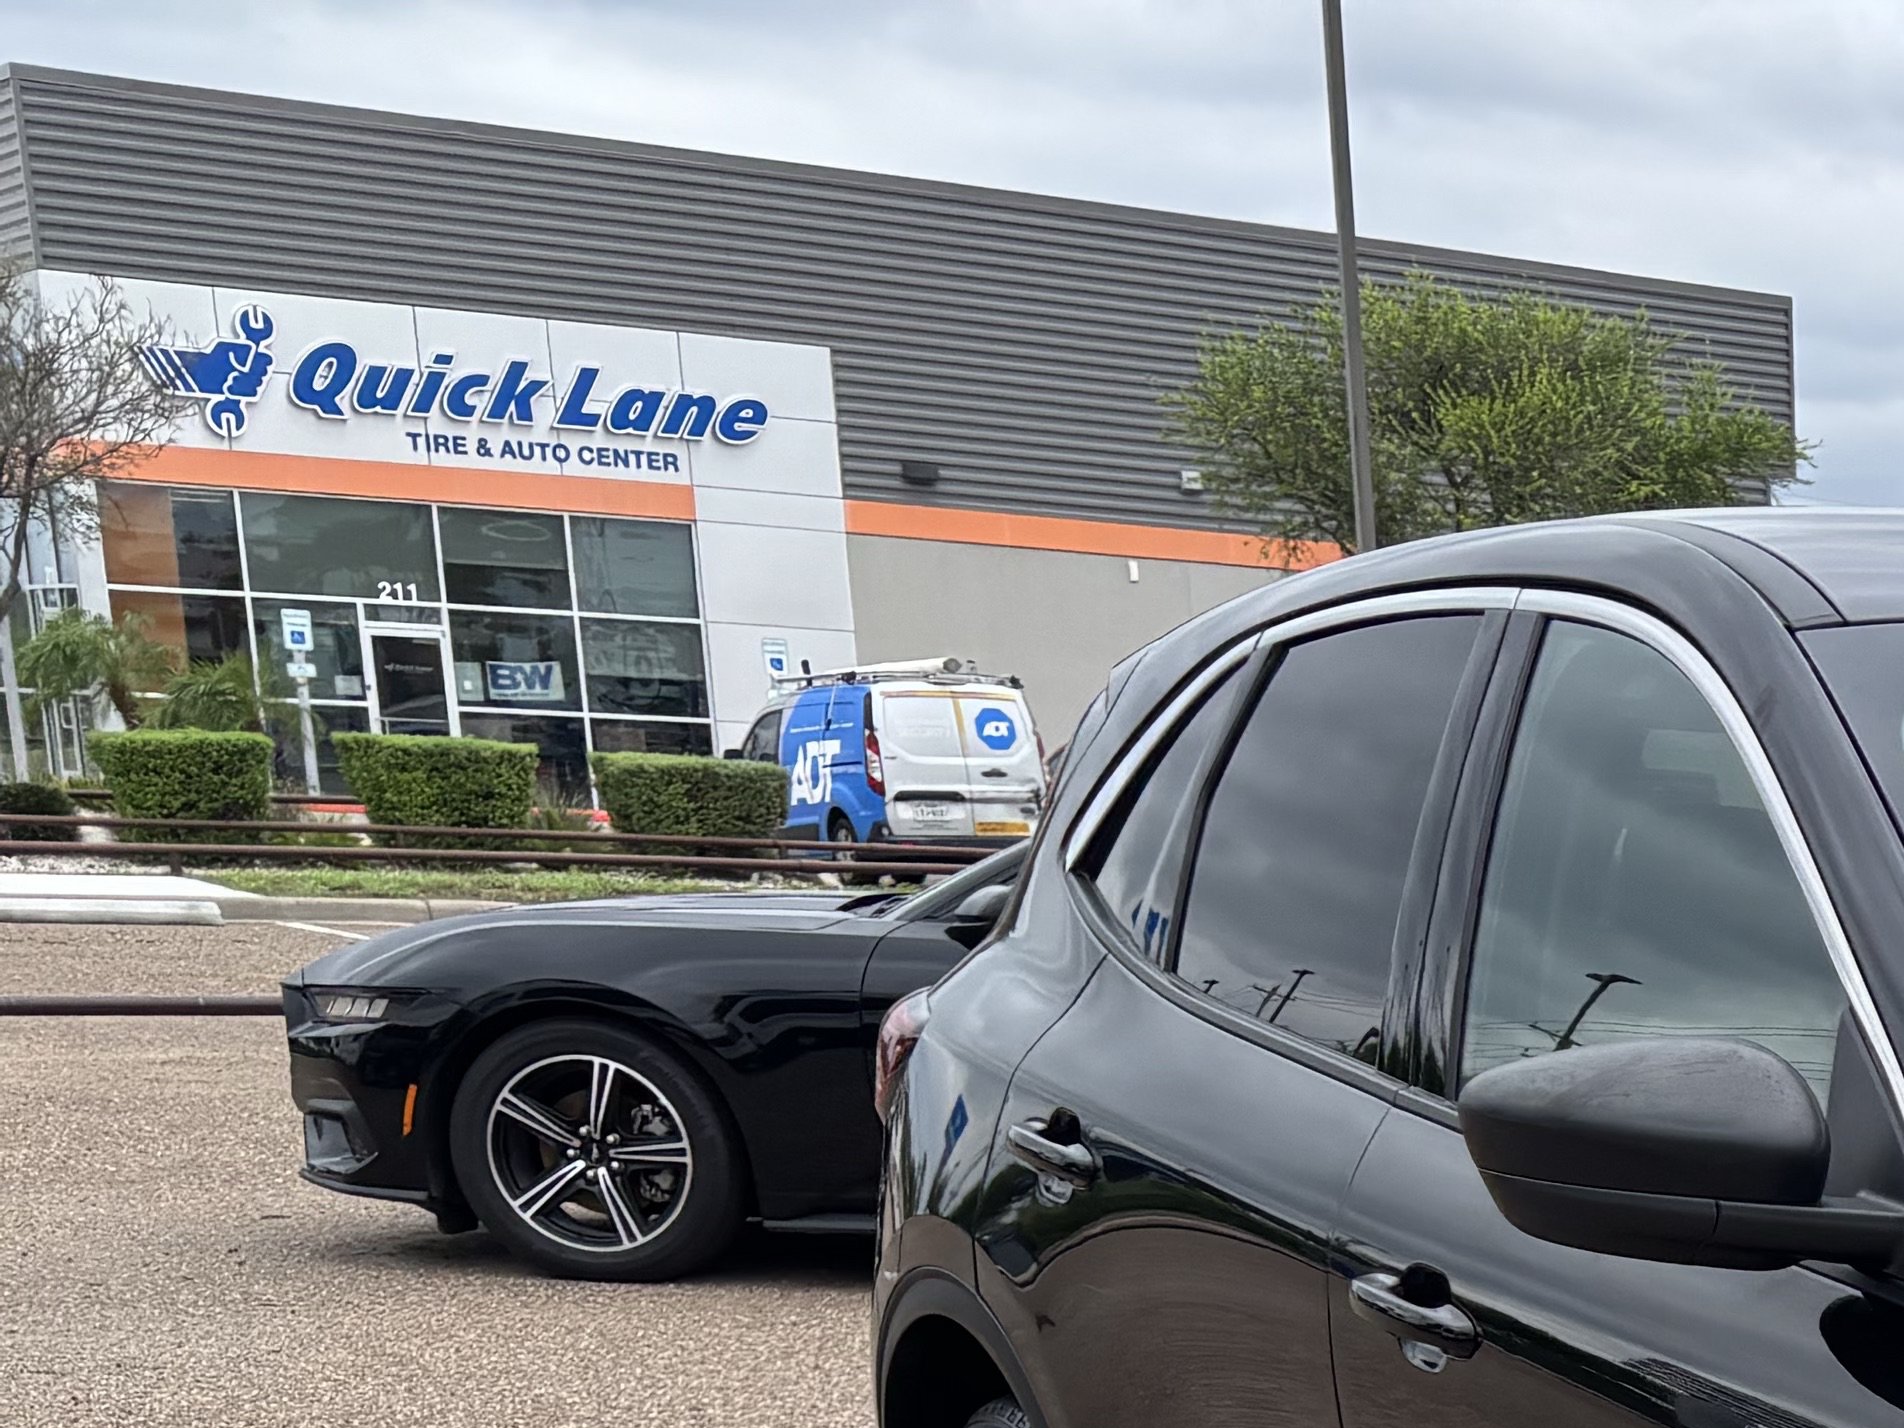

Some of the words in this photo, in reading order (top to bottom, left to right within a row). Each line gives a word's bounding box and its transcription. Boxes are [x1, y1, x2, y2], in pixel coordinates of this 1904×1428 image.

[291, 340, 552, 423] Quick
[555, 366, 770, 442] Lane
[405, 431, 468, 456] TIRE
[476, 437, 494, 458] &
[499, 439, 571, 464] AUTO
[577, 445, 680, 473] CENTER
[377, 581, 418, 601] 211
[790, 739, 841, 806] ADT
